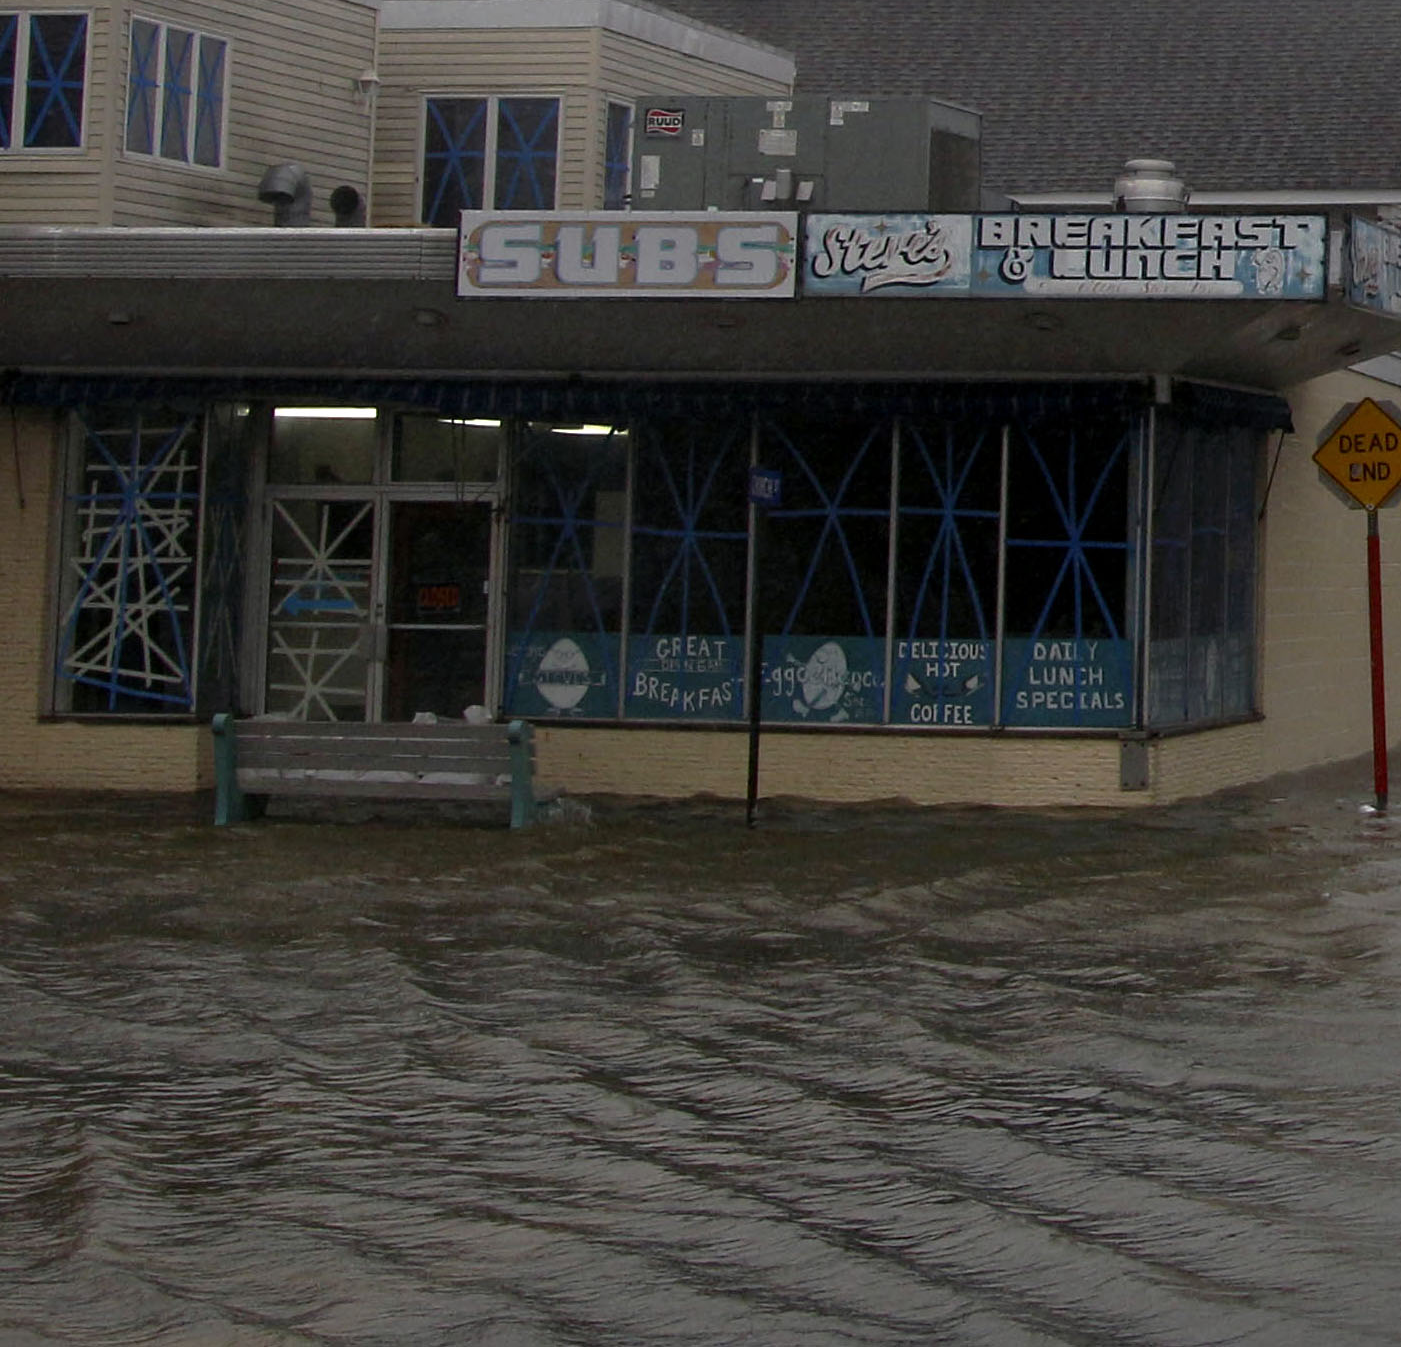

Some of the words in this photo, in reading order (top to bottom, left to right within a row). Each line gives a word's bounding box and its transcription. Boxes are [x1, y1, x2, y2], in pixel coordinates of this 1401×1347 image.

[648, 117, 681, 126] RUUD
[978, 216, 1311, 250] BREAKFAST
[478, 223, 779, 285] SUBS
[812, 219, 951, 292] Steve's
[1051, 249, 1237, 281] LUNCH
[1339, 432, 1399, 454] DEAD
[1348, 461, 1391, 483] END
[655, 635, 727, 661] GREAT
[1032, 640, 1099, 661] DAILY
[925, 662, 961, 678] HOT
[1028, 665, 1103, 686] LUNCH
[1015, 690, 1125, 710] SPECIALS
[909, 702, 974, 725] COFFEE
